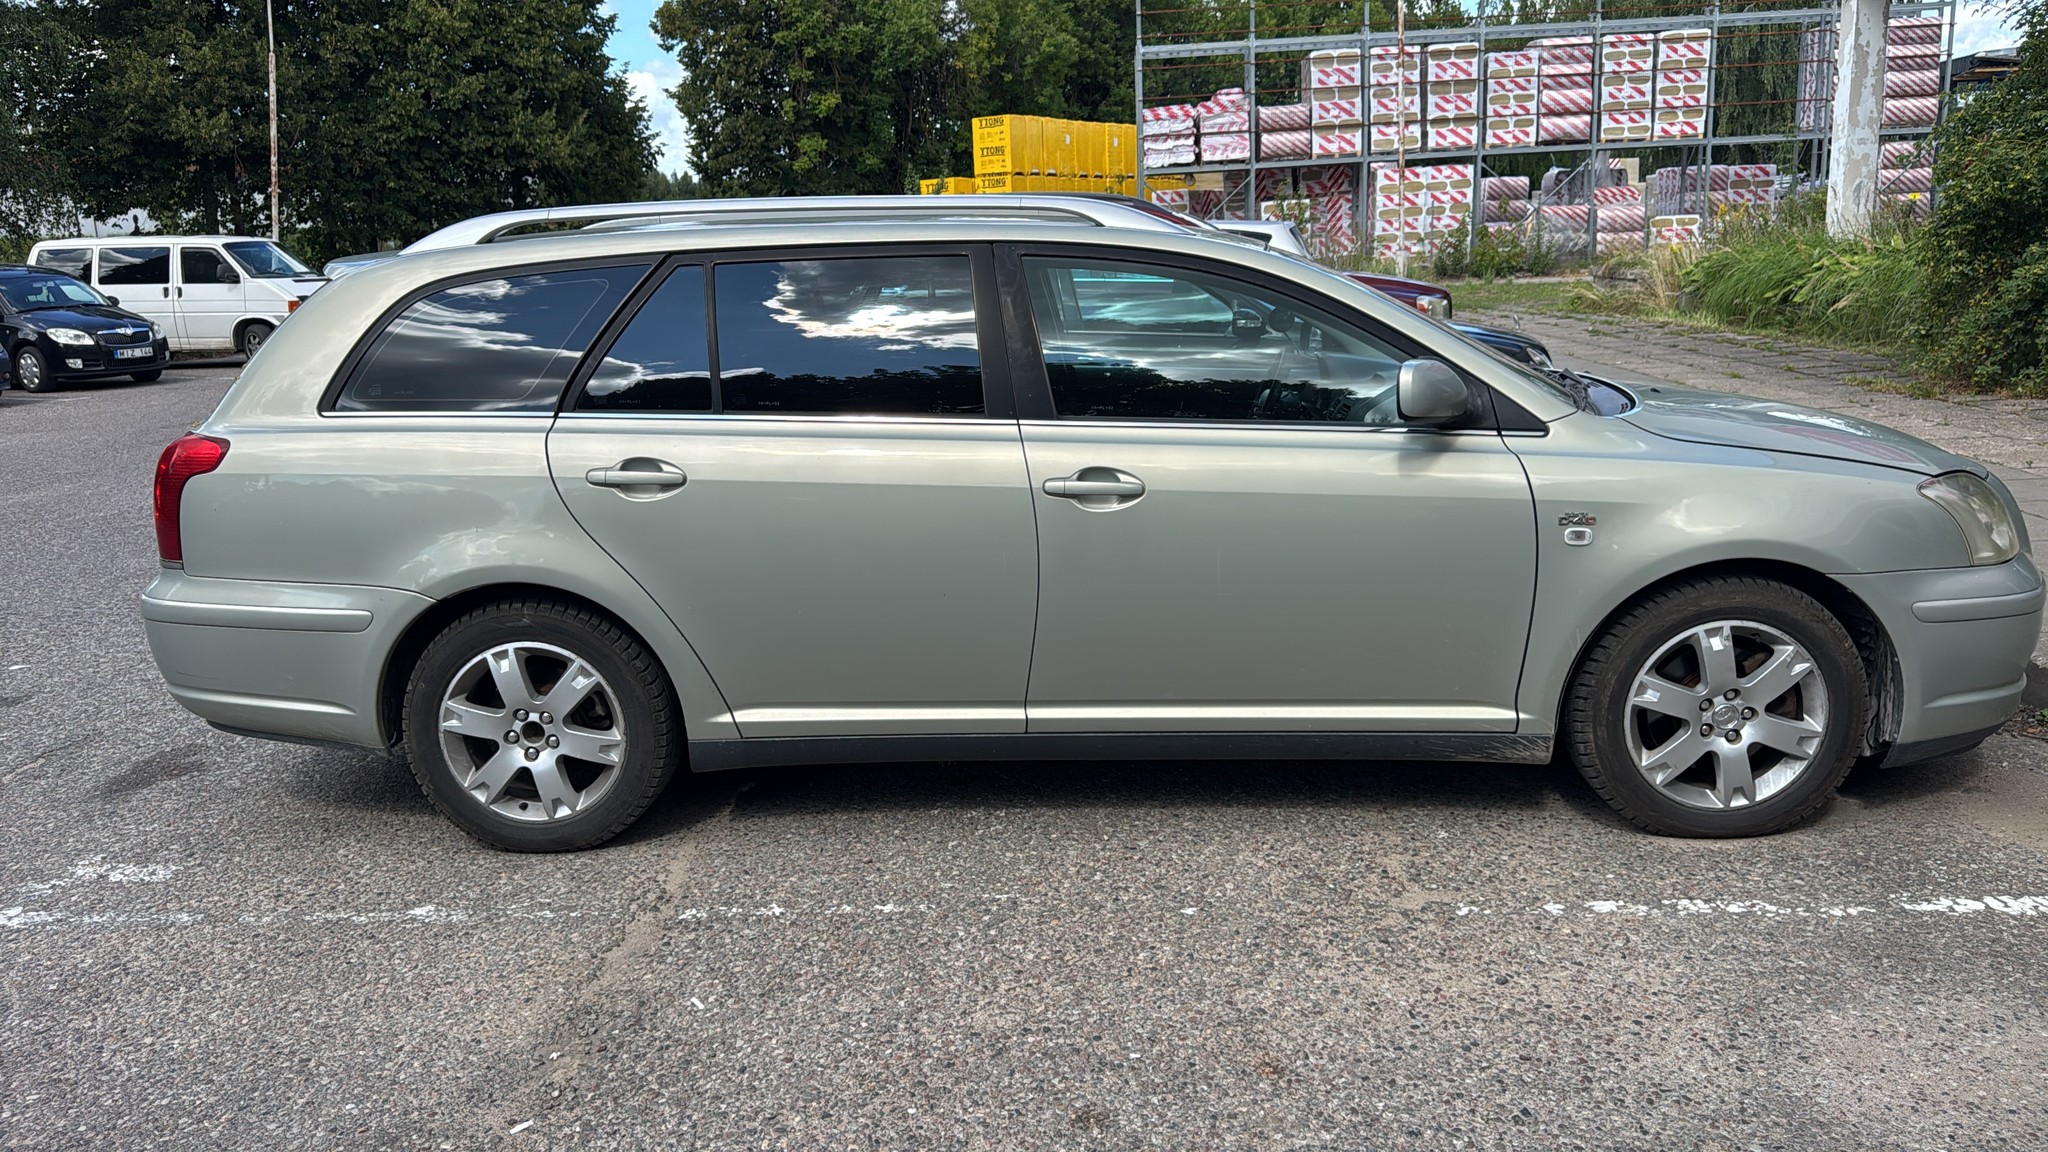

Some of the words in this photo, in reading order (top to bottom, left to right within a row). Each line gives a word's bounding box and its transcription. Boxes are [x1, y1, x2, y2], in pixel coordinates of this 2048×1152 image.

[978, 116, 1004, 127] YTONG
[980, 145, 1005, 156] YTONG
[981, 177, 1006, 187] YTONG
[140, 348, 152, 356] 144
